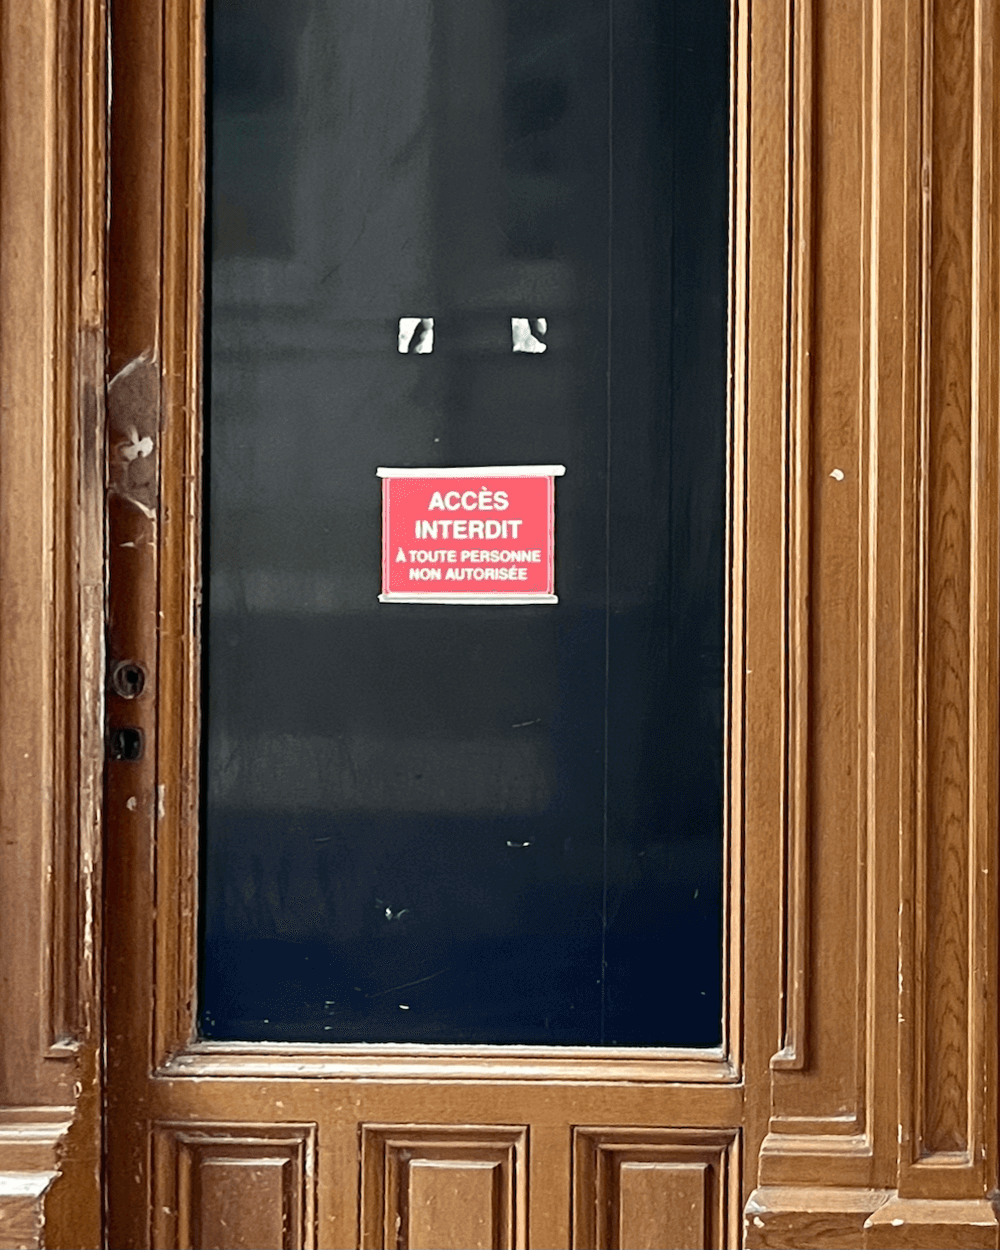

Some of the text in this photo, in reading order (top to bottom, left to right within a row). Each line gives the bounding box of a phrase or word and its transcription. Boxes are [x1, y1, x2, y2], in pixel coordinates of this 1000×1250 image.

[428, 486, 509, 511] ACCÈS
[415, 520, 523, 539] INTERDIT
[395, 547, 541, 563] À TOUTE PERSONNE
[409, 565, 528, 580] NON AUTORISÉE
